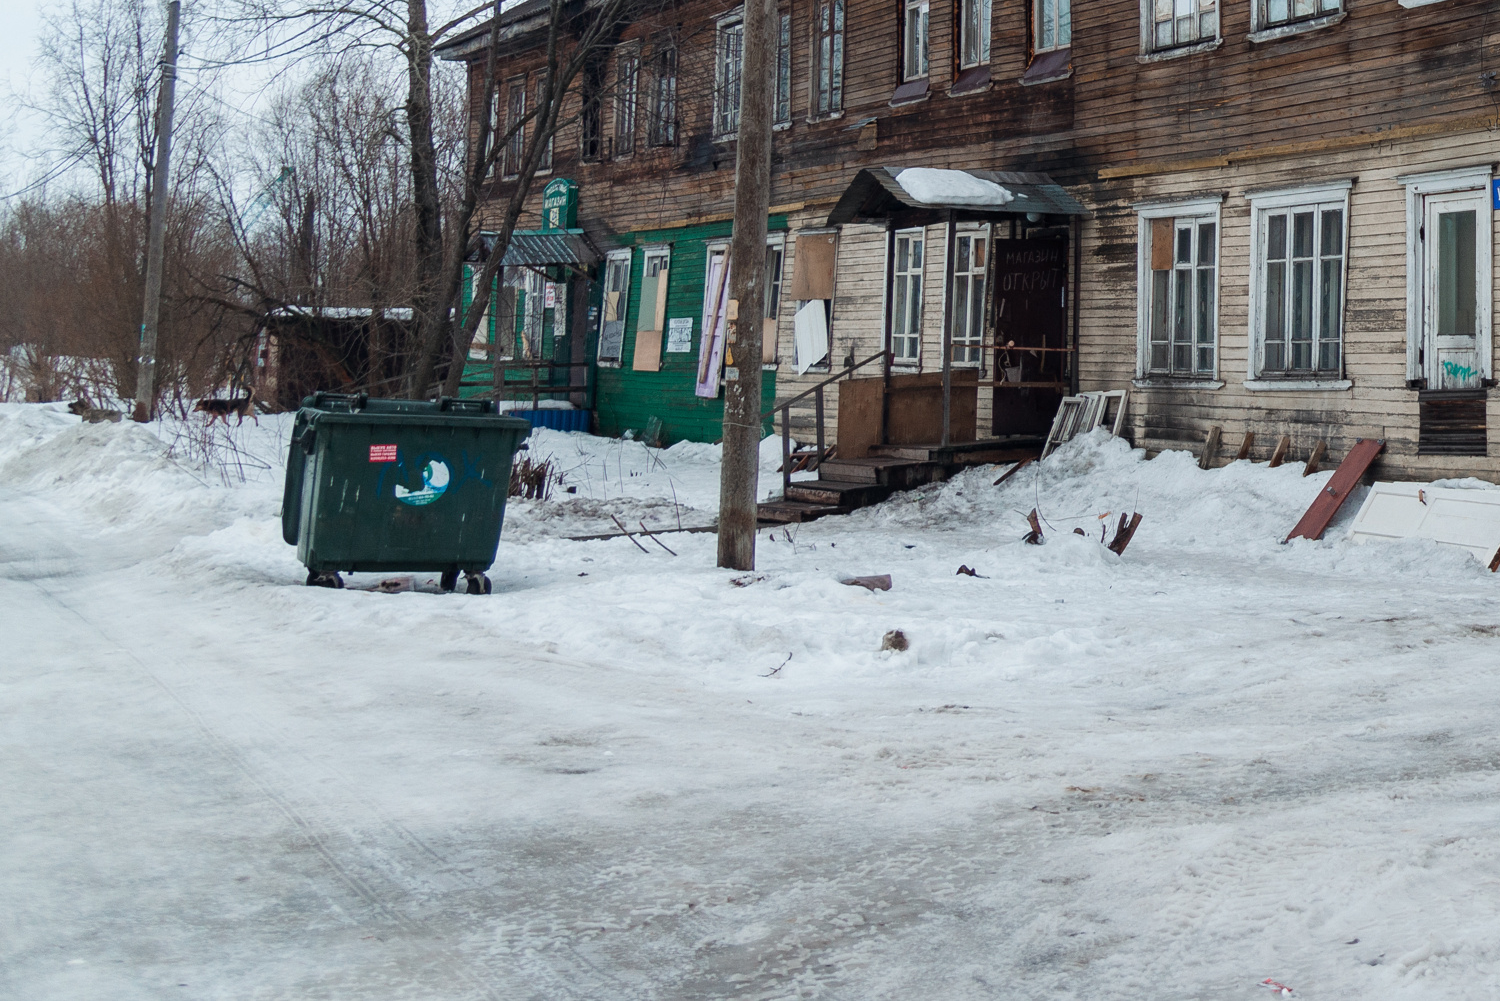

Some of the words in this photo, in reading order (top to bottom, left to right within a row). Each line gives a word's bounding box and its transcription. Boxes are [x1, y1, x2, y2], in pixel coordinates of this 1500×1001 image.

[544, 196, 567, 209] МАГАЗИН
[1006, 248, 1059, 265] МАГАЗИН
[1003, 268, 1062, 292] ОТКРЫТ
